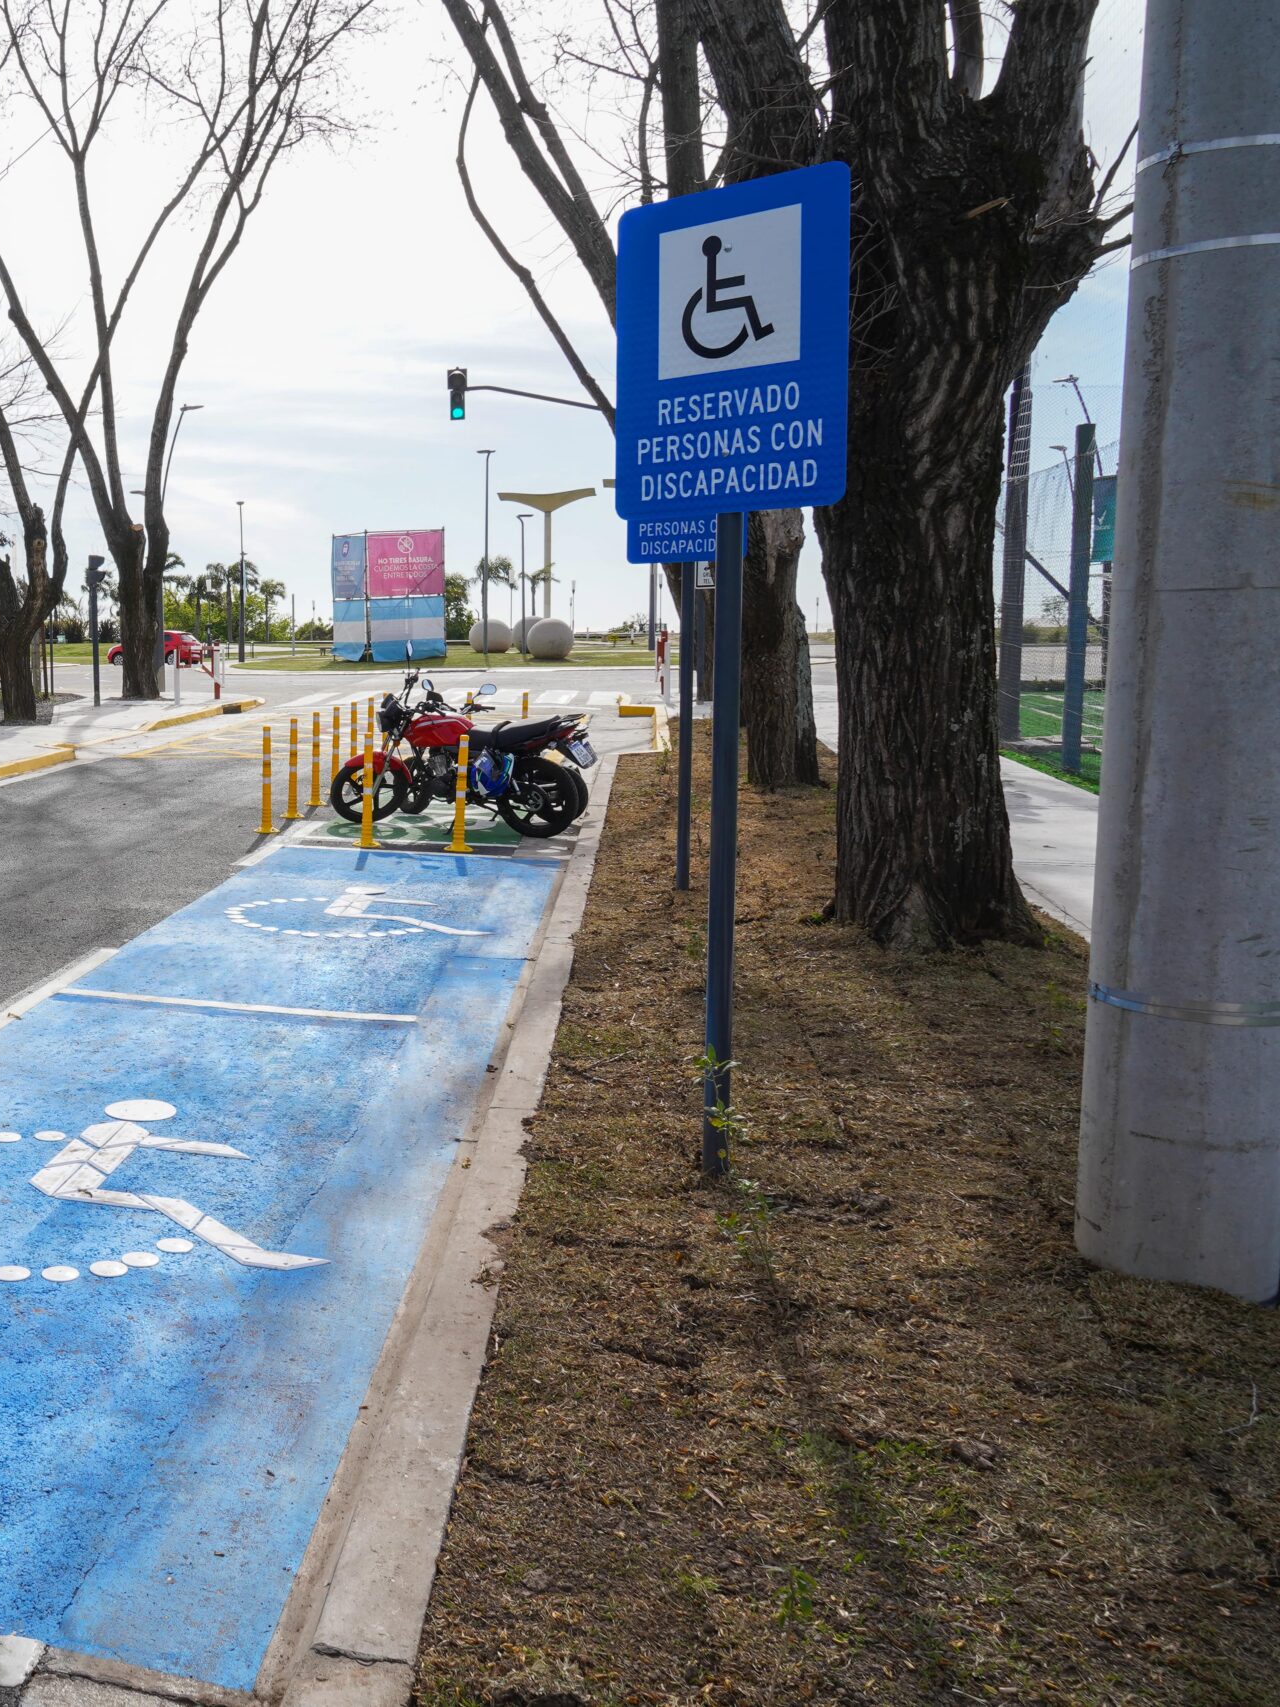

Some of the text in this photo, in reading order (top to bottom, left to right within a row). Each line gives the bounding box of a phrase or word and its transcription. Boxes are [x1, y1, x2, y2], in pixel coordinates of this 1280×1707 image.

[658, 381, 800, 426] RESERVADO
[637, 418, 823, 465] PERSONAS CON
[641, 459, 818, 501] DISCAPACIDAD
[639, 520, 705, 537] PERSONAS
[641, 538, 716, 556] DISCAPACID
[373, 564, 408, 572] CUIDEMOS
